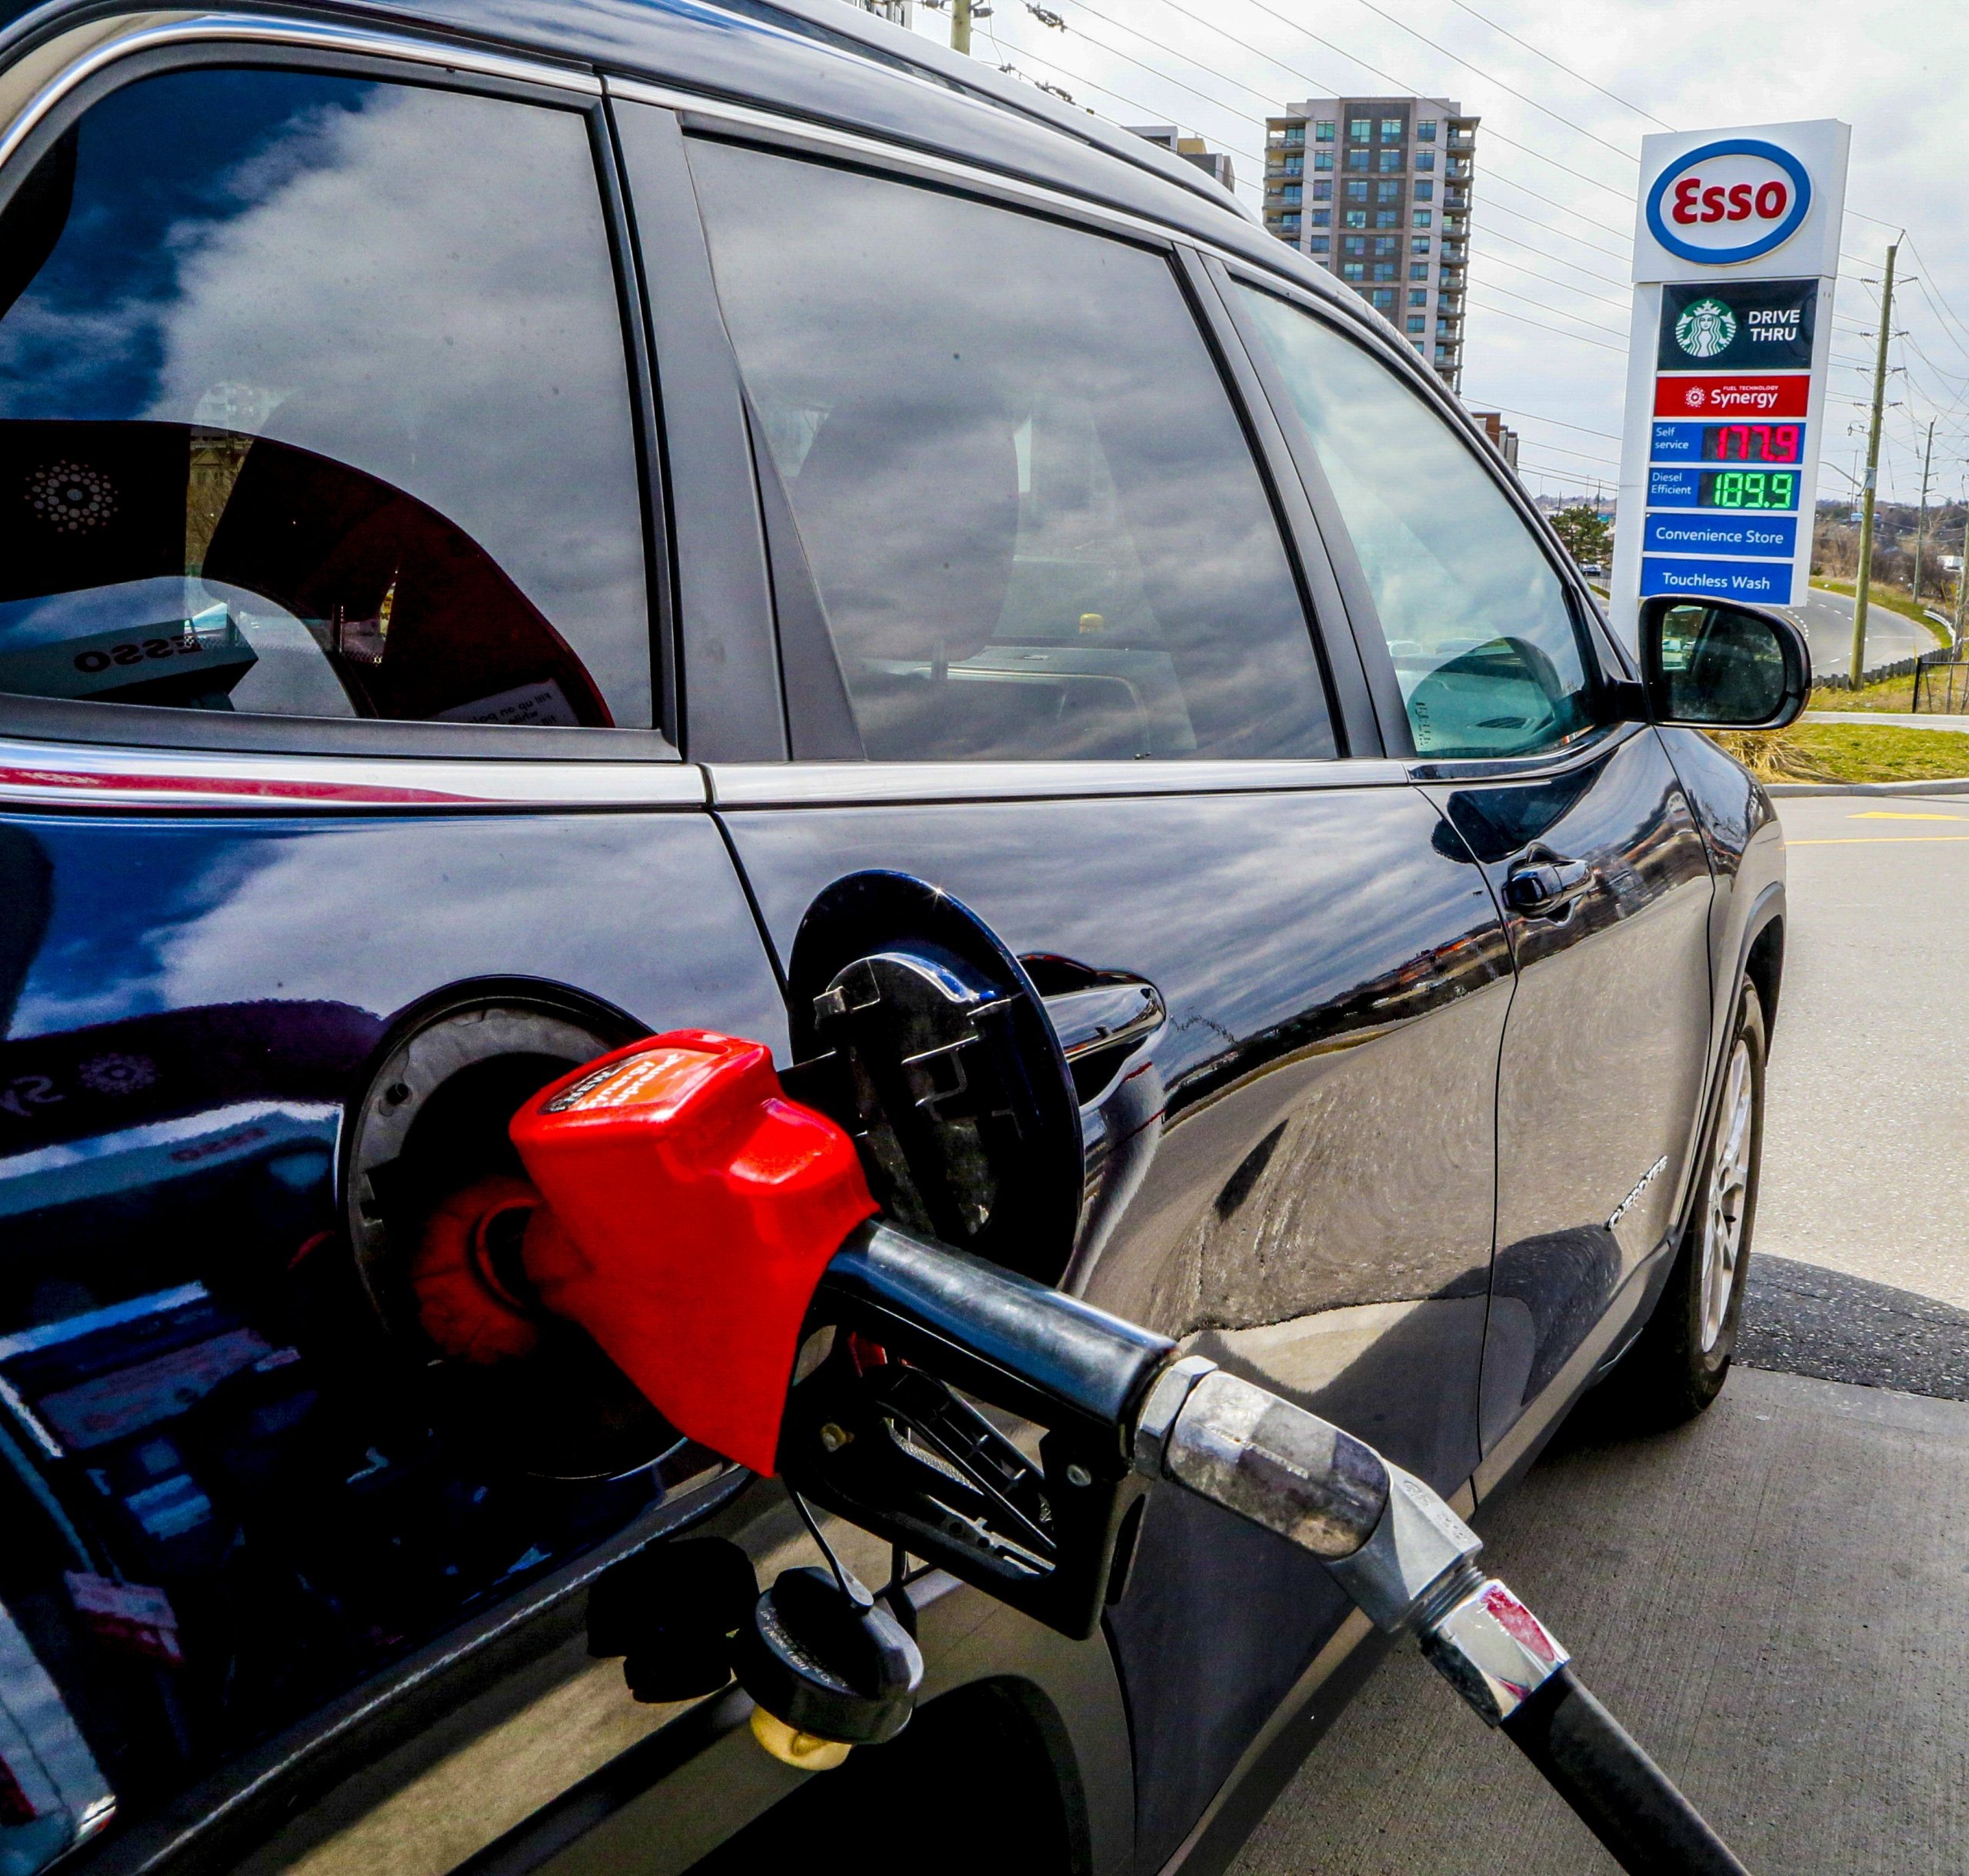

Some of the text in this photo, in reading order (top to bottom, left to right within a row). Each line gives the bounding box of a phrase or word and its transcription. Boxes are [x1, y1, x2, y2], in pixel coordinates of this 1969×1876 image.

[1748, 309, 1801, 325] DRIVE
[1751, 328, 1797, 342] THRU
[1711, 389, 1778, 408] Synergy
[1656, 427, 1675, 437] Self
[1655, 441, 1689, 450] service
[1717, 425, 1799, 462] 177.9
[1652, 472, 1682, 482] Diesel
[1651, 485, 1691, 495] Efficient
[1714, 473, 1793, 508] 189.9
[1656, 528, 1784, 544] Convenience Store
[1663, 572, 1770, 590] Touchless Wash
